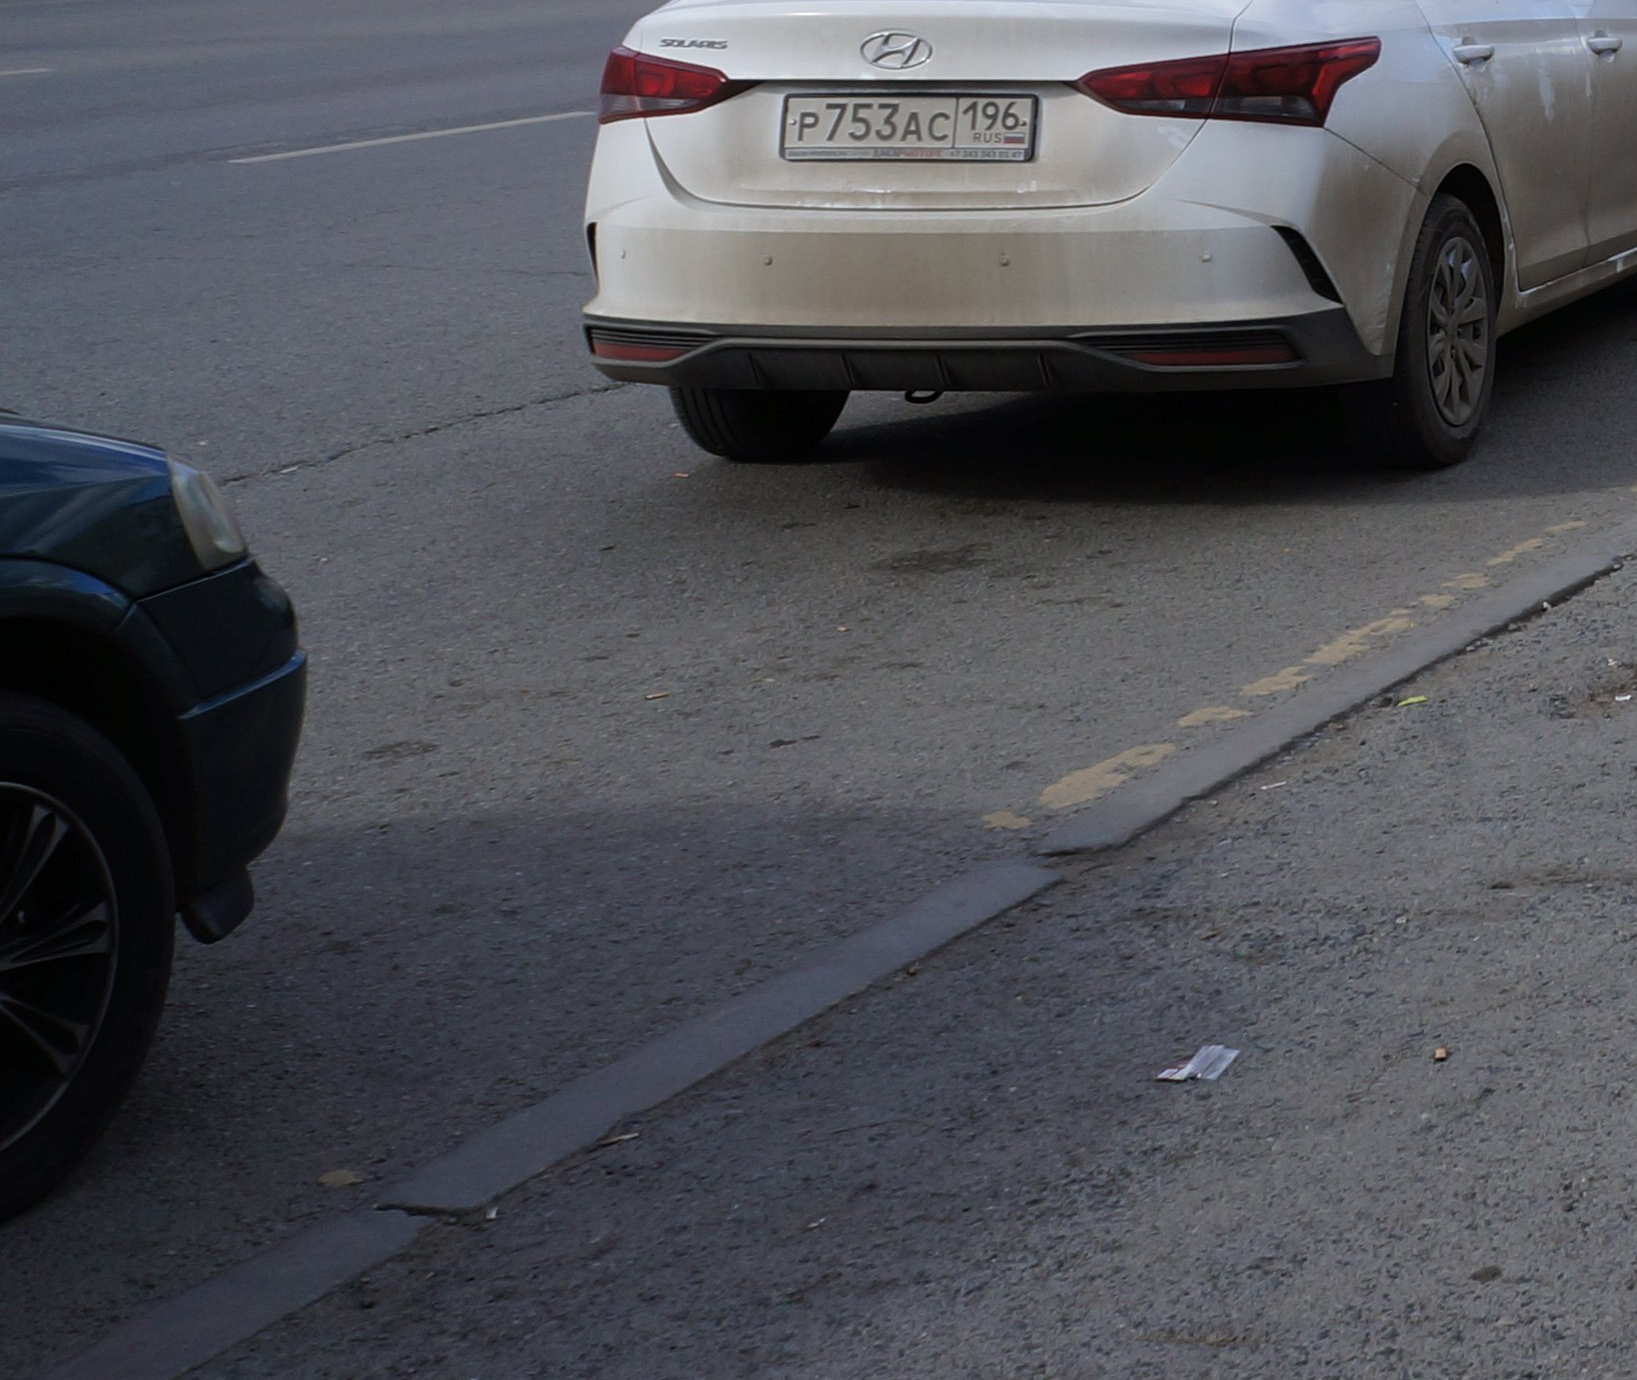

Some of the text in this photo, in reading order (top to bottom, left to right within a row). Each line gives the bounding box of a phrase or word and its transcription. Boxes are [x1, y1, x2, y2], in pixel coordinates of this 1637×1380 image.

[796, 101, 1020, 142] Р753АС 196
[973, 132, 1002, 144] RUS
